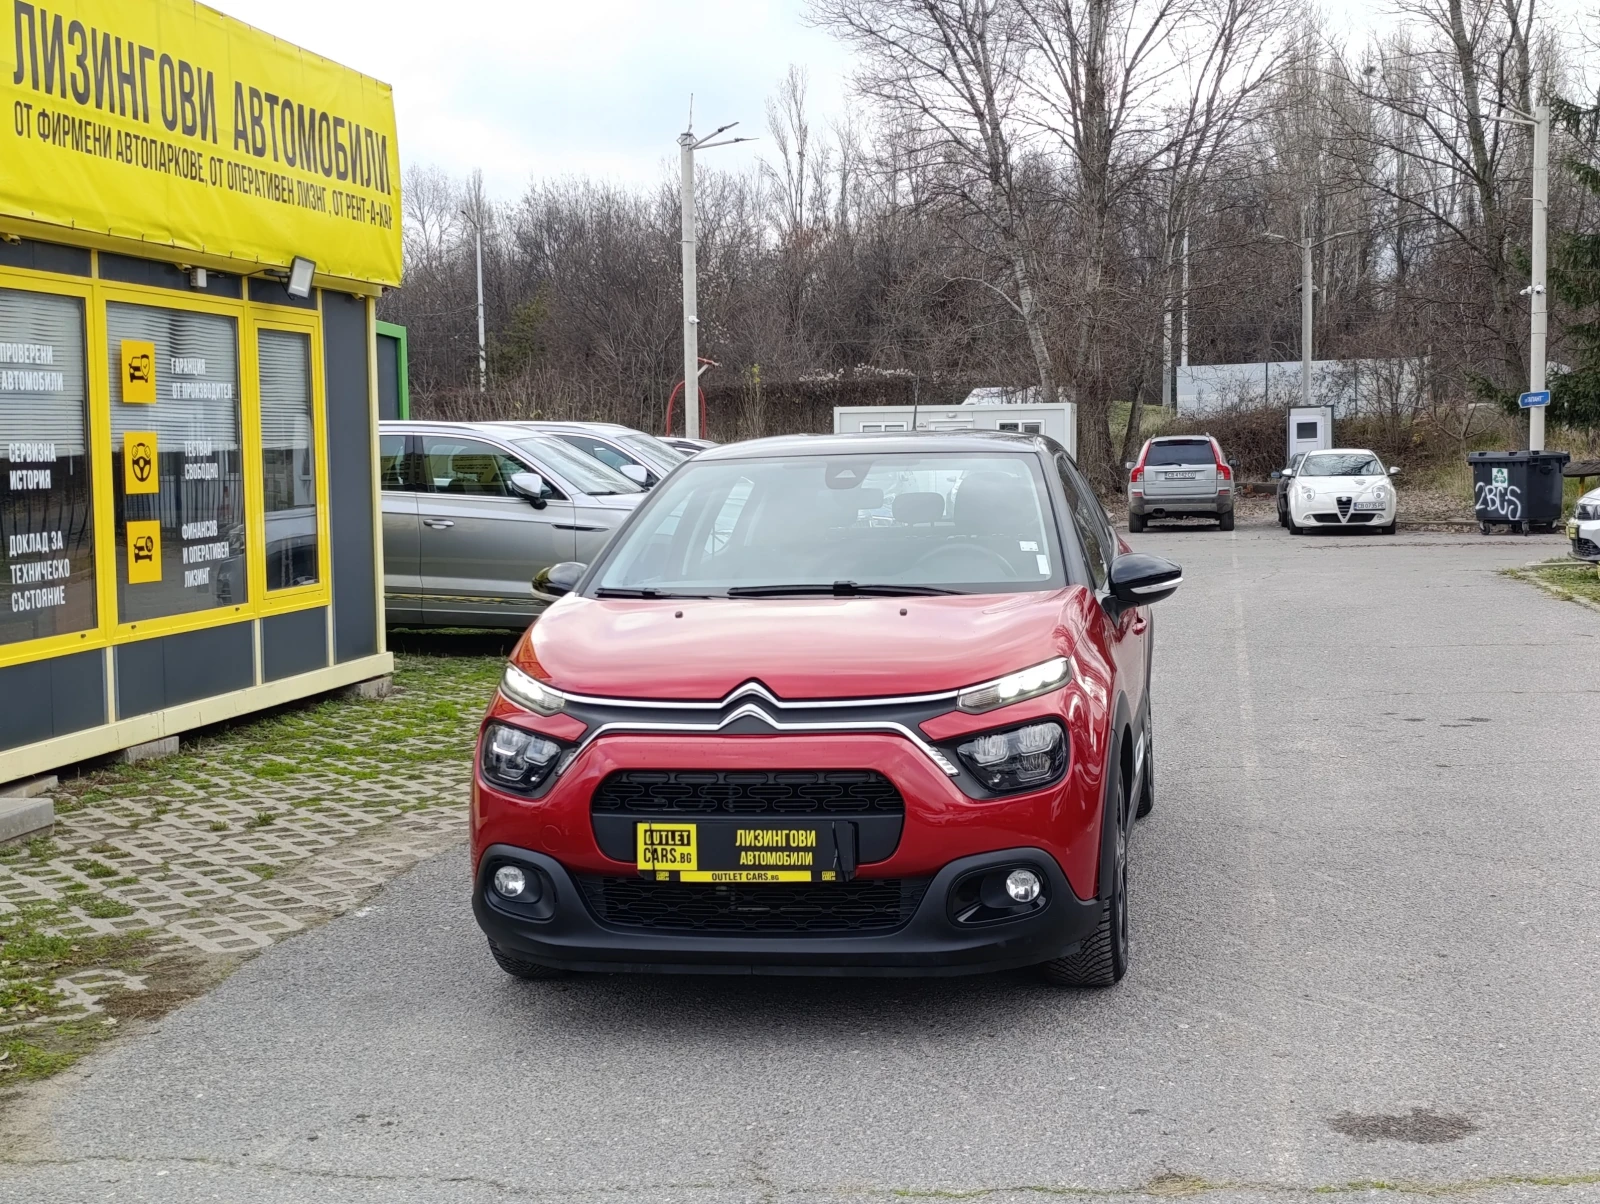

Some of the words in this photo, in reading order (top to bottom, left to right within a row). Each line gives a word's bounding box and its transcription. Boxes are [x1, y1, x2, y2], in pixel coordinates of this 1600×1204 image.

[13, 0, 218, 145] ЛИЗИНГОВИ
[233, 80, 392, 196] АВТОМОБИЛИ
[14, 100, 33, 139] ОТ
[37, 107, 113, 160] ФИРМЕНИ
[115, 129, 208, 188] АВТОПАРКОВЕ,
[209, 156, 224, 188] ОТ
[226, 160, 295, 206] ОПЕРАТИВЕН
[332, 189, 344, 218] ОТ
[0, 343, 53, 365] ПРОВЕРЕНИ
[171, 357, 206, 376] ГАРАНЦИЯ
[1, 370, 64, 391] АВТОМОБИЛИ
[172, 382, 181, 399] ОТ
[9, 442, 57, 463] СЕРВИЗНА
[9, 469, 51, 490] ИСТОРИЯ
[184, 463, 219, 480] СВОБОДНО
[182, 519, 218, 540] ФИНАНСОВ
[9, 532, 49, 557] ДОКЛАД
[51, 530, 63, 550] ЗА
[182, 547, 188, 565] И
[189, 541, 230, 564] ОПЕРАТИВЕН
[10, 558, 70, 585] ТЕХНИЧЕСКО
[184, 567, 211, 588] ЛИЗИНГ
[11, 585, 66, 613] СЪСТОЯНИЕ
[645, 831, 690, 845] OUTLET
[735, 829, 816, 848] ЛИЗИНГОВИ
[644, 847, 692, 864] CARS.BG
[739, 851, 813, 866] АВТОМОБИЛИ
[711, 872, 744, 881] OUTLET
[746, 872, 780, 881] CARS.BG
